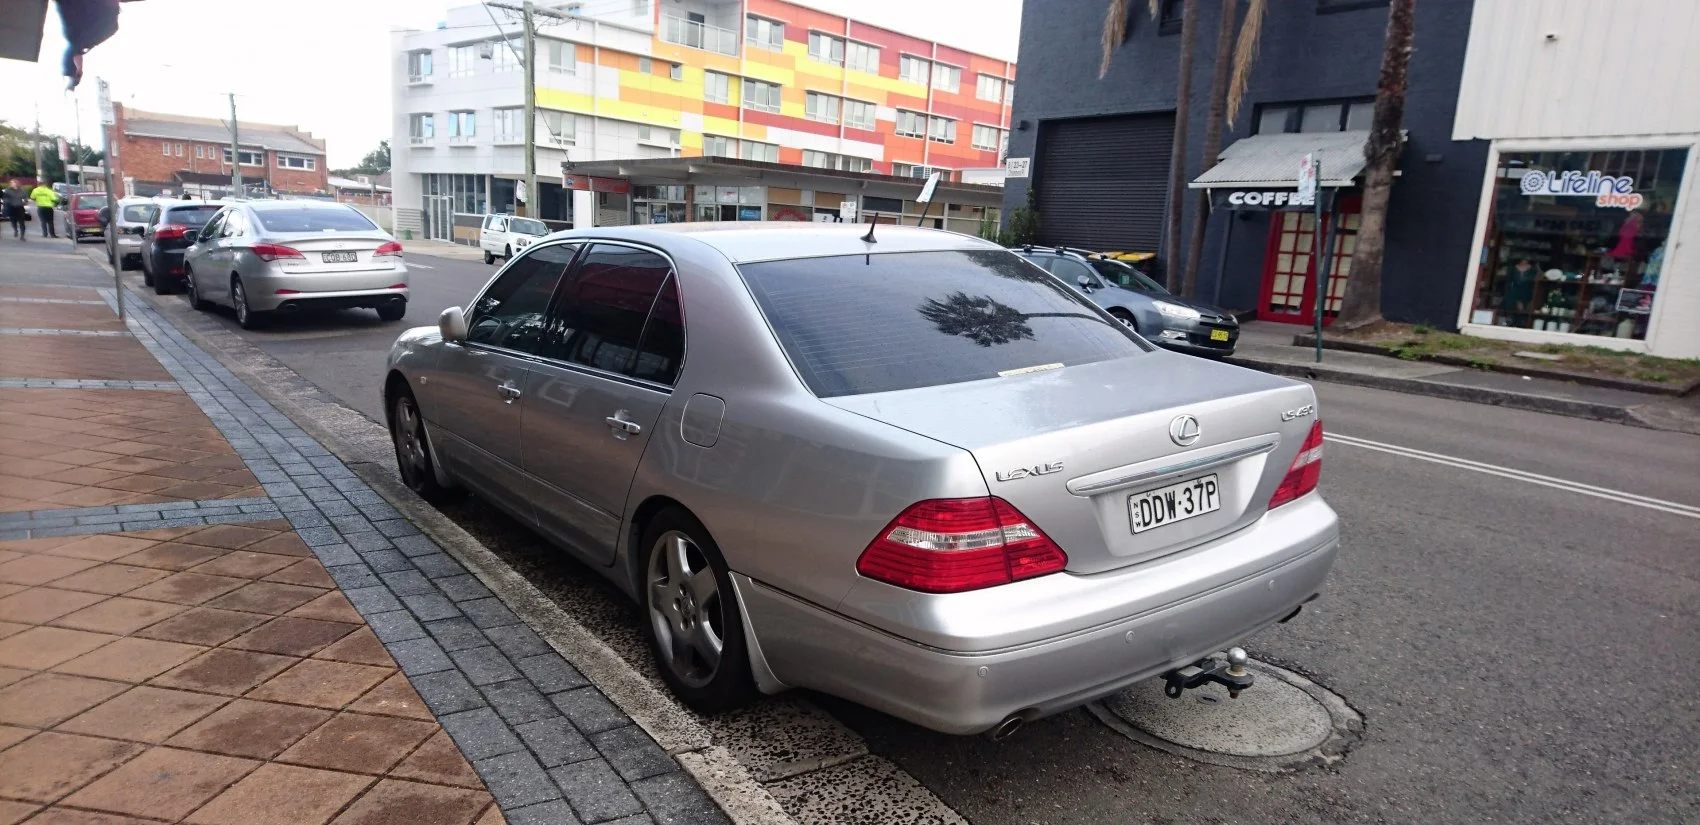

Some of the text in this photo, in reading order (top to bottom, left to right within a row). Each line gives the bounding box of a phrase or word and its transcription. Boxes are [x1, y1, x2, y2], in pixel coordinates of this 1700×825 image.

[1548, 172, 1631, 193] Lifeline
[1599, 194, 1640, 208] shop
[995, 461, 1064, 482] LEXUS
